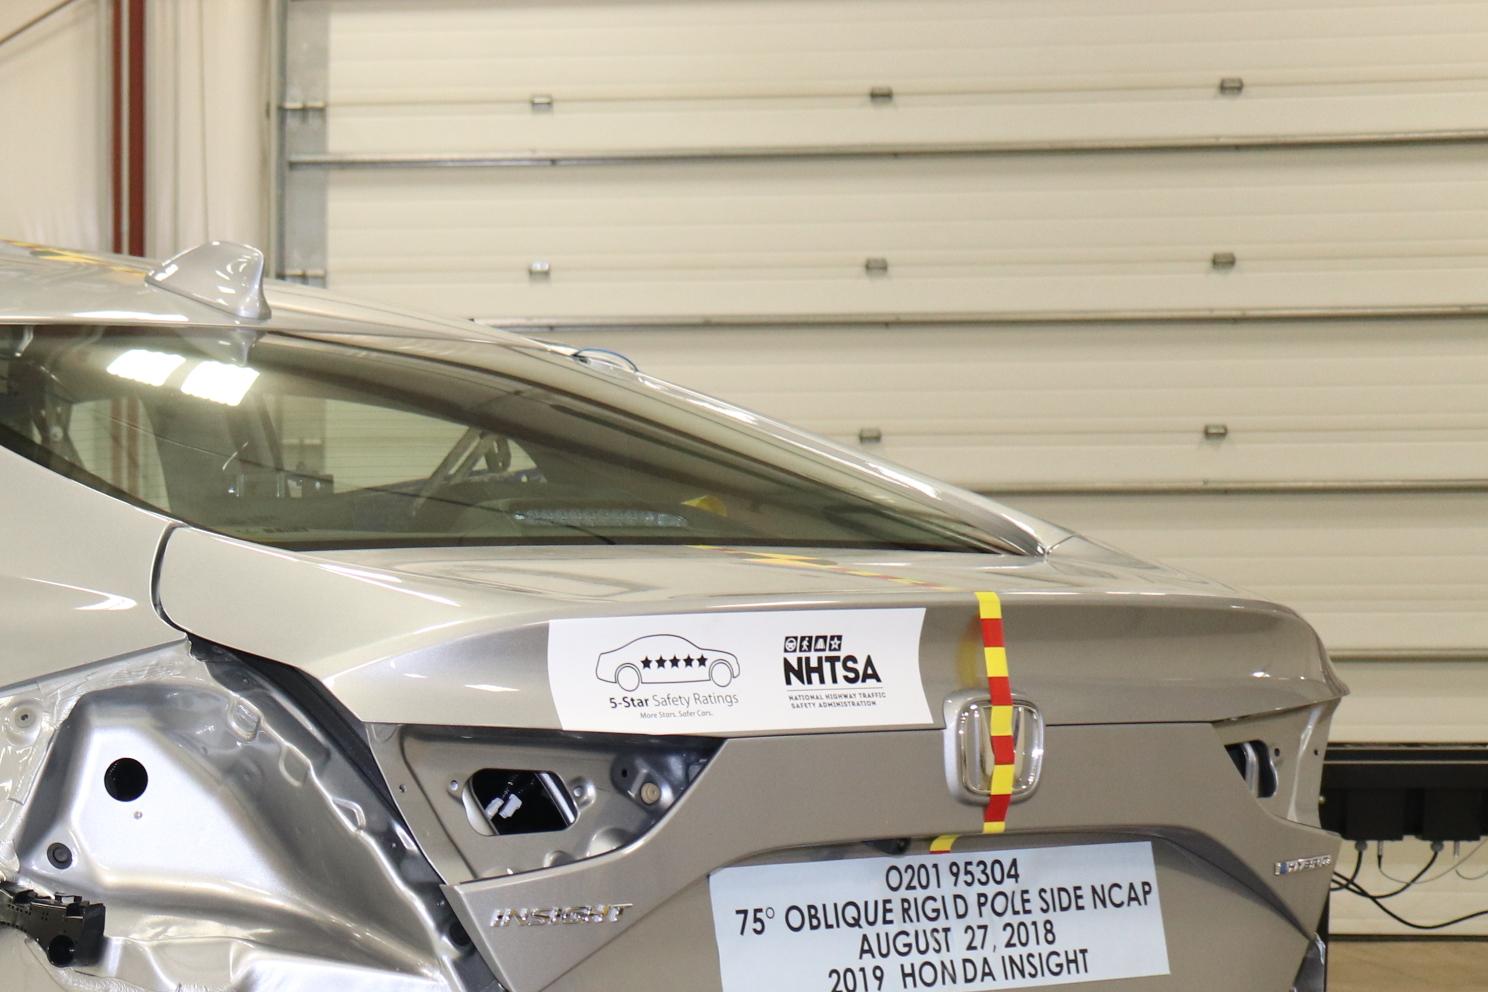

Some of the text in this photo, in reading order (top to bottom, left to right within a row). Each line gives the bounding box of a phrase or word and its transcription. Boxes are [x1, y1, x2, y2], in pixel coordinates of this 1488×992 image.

[783, 654, 882, 686] NHTSA
[609, 692, 739, 709] 5-Star Safety Ratings
[678, 710, 696, 718] Safer
[697, 709, 713, 717] Cars.
[818, 700, 877, 708] ADMINISTRATION
[785, 898, 895, 933] OBLIQUE
[900, 893, 968, 924] RIGID
[976, 889, 1032, 918] POLE
[1038, 885, 1086, 914] SIDE
[1091, 881, 1152, 910] NCAP
[858, 919, 1056, 960] AUGUST 27, 2018
[900, 956, 996, 990] HONDA
[1001, 948, 1089, 981] INSIGHT
